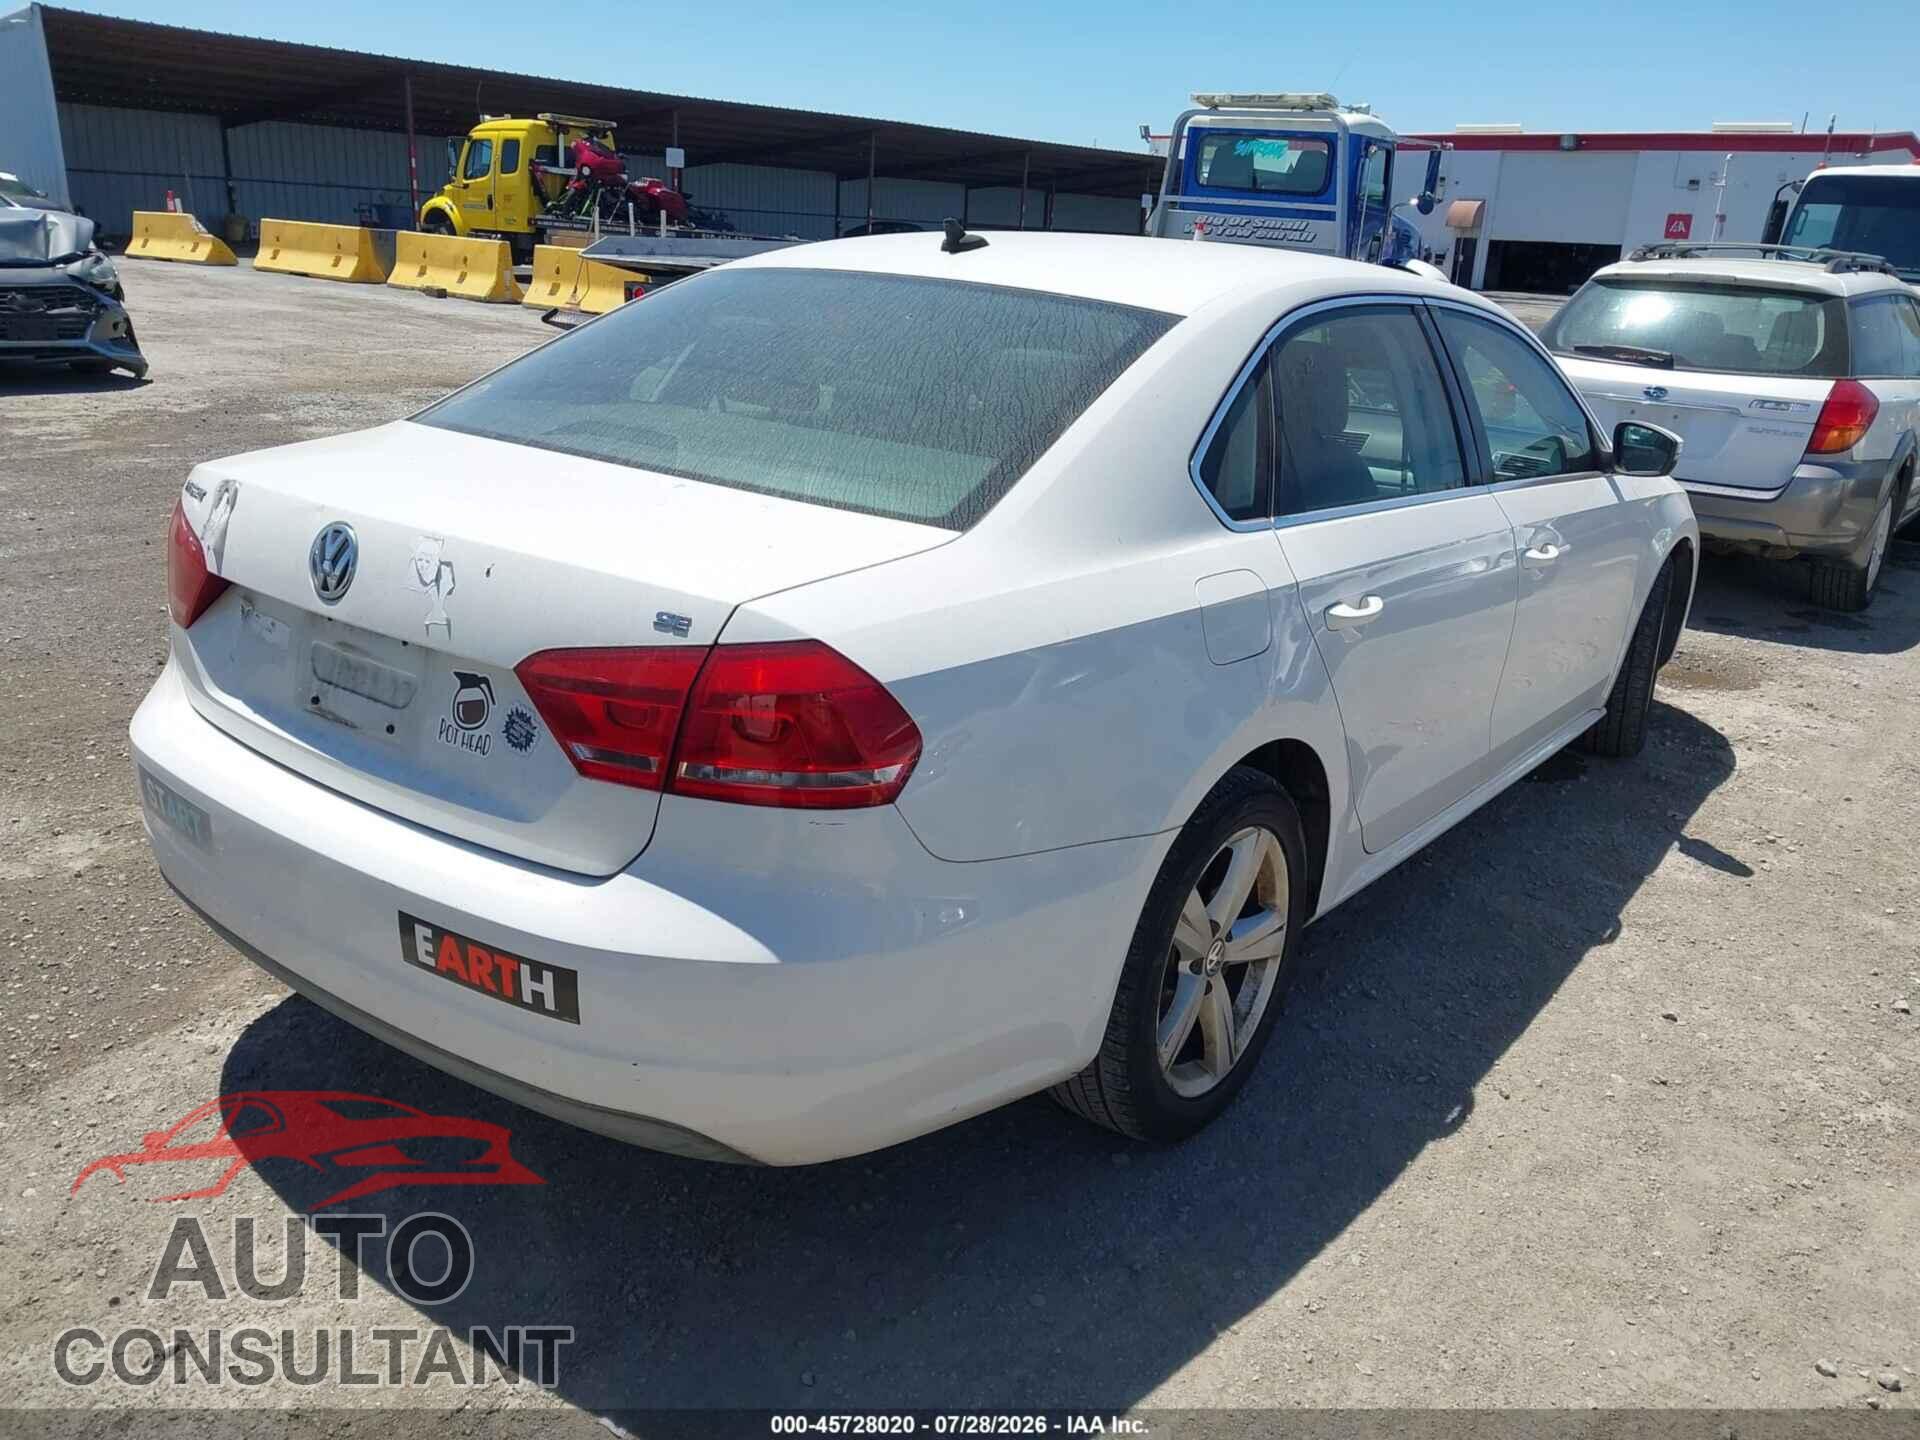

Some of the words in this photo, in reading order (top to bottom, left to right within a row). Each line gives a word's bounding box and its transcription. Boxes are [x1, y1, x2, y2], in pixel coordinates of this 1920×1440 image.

[1252, 218, 1309, 231] Small
[653, 611, 692, 638] SE
[438, 718, 460, 745] POT
[460, 732, 492, 756] HEAD
[414, 923, 557, 1012] EARTH
